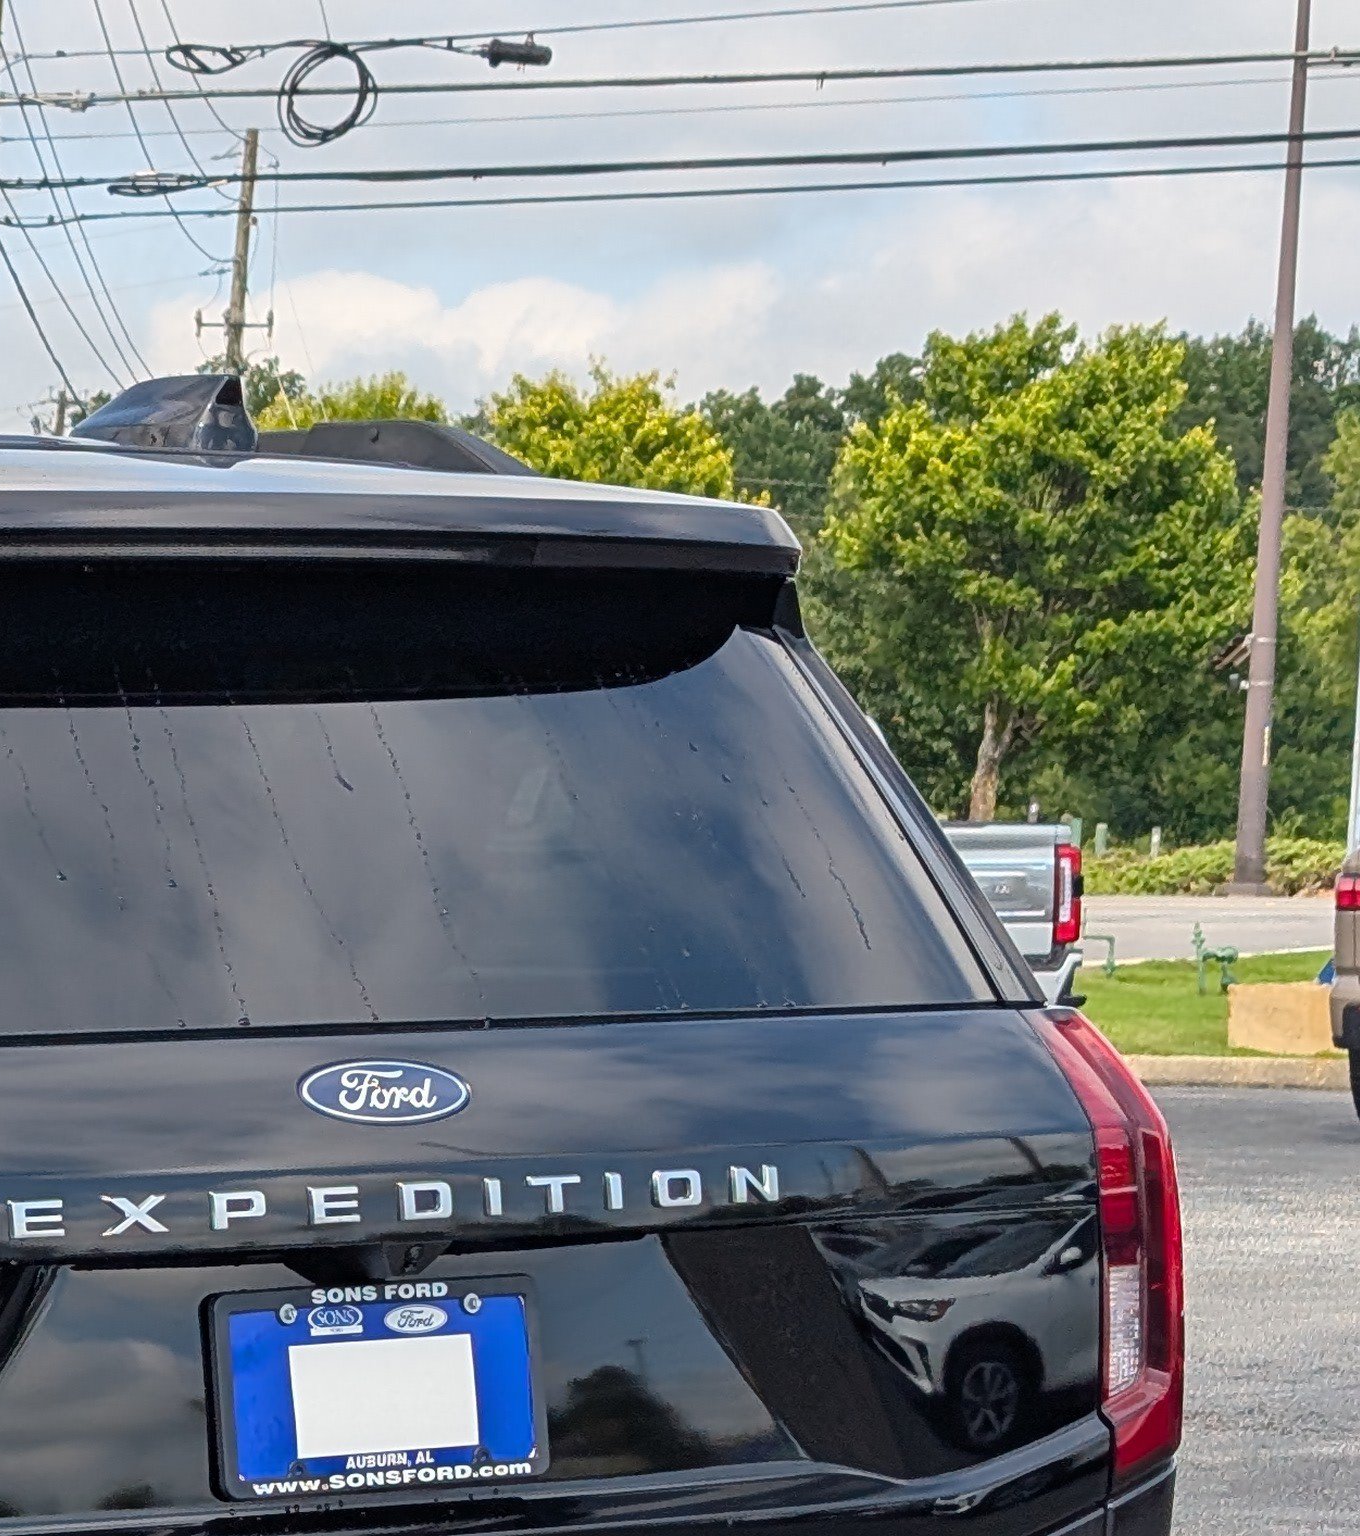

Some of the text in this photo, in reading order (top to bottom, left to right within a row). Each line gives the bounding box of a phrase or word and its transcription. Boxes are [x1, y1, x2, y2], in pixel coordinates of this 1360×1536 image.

[338, 1069, 437, 1111] Ford
[7, 1163, 780, 1239] EXPEDITION
[311, 1282, 448, 1304] SONS FORD
[397, 1309, 434, 1328] Ford
[415, 1449, 435, 1464] AL
[253, 1462, 531, 1496] www.SONSFORD.com
